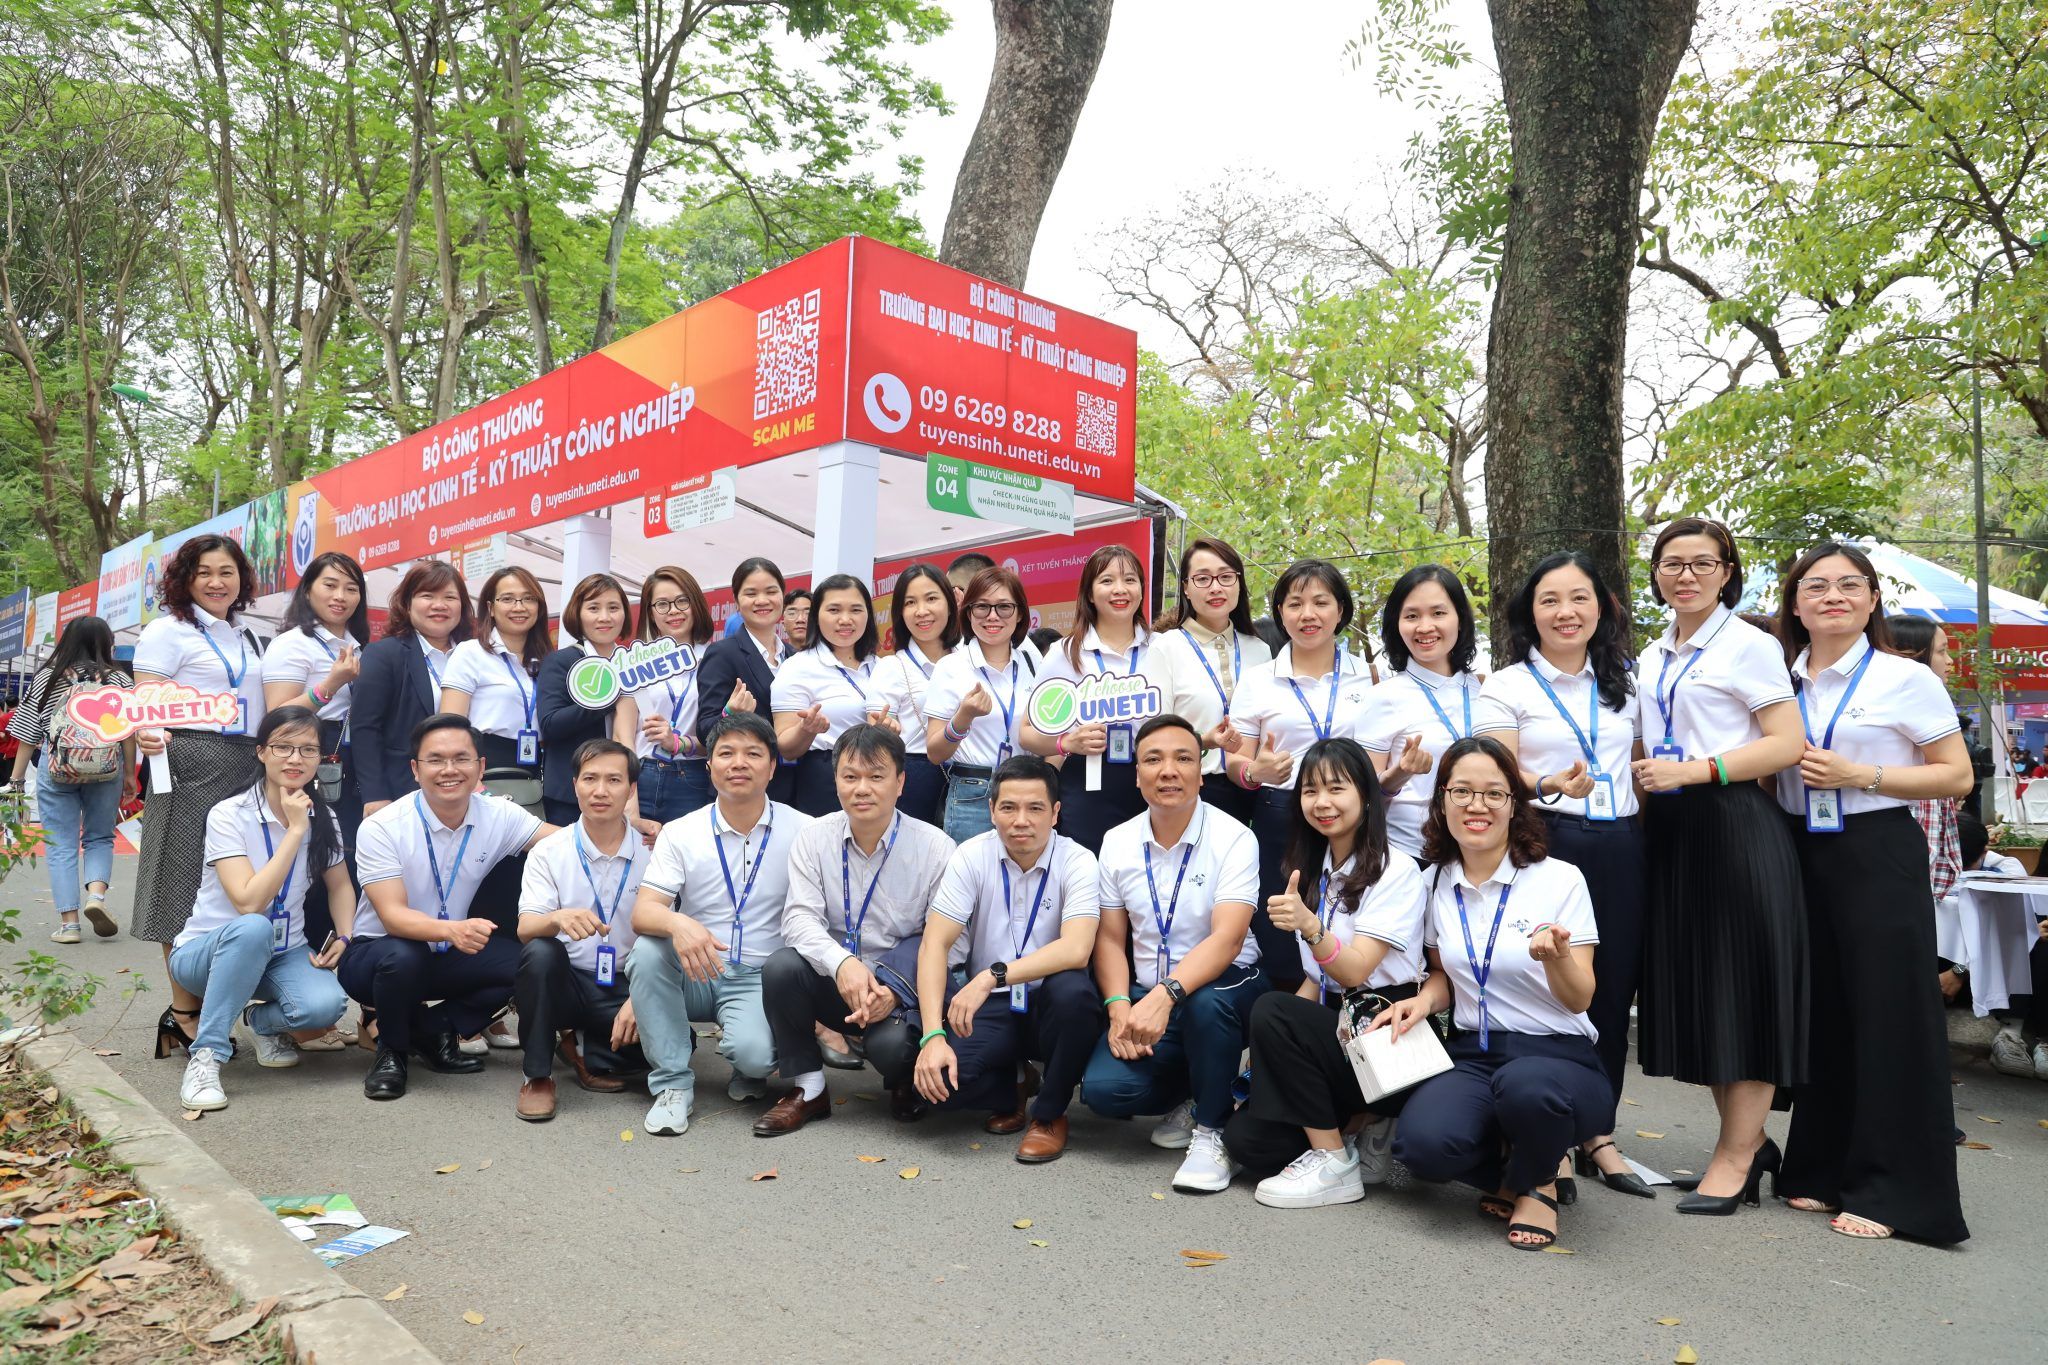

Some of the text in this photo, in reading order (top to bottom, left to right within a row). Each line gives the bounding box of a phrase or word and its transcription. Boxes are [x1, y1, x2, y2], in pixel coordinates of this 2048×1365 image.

[970, 282, 1056, 333] BỘ CÔNG THƯƠNG
[880, 289, 925, 326] TRƯỜNG
[928, 305, 947, 336] ĐẠI
[949, 311, 971, 343] HỌC
[973, 319, 999, 349] KINH
[1001, 325, 1014, 353] TẾ
[1036, 340, 1065, 373] THUẬT
[1067, 348, 1093, 378] CÔNG
[1094, 359, 1127, 392] NGHIỆP
[919, 385, 1062, 443] 09 6269 8288
[422, 398, 544, 475] BỘ CÔNG THƯƠNG
[752, 413, 815, 447] SCAN ME
[335, 503, 376, 538] TRƯỜNG
[378, 496, 398, 528] ĐẠI
[401, 486, 426, 520] HỌC
[428, 474, 459, 508] KINH
[462, 456, 479, 497] TẾ
[489, 449, 508, 488] KỸ
[511, 432, 561, 480] THUẬT
[565, 416, 615, 461] CÔNG
[620, 382, 695, 443] NGHIỆP
[919, 420, 1101, 479] tuyensinh.uneti.edu.vn
[937, 463, 959, 475] ZONE
[973, 466, 1037, 489] KHU VỰC NHẬN QUÀ
[546, 468, 640, 508] tuyensinh.uneti.edu.vn
[935, 476, 959, 499] 04
[992, 489, 1021, 501] CHECK-IN
[1039, 499, 1057, 508] UNETI
[440, 506, 516, 540] tuyensinh@uneti.edu.vn
[648, 506, 661, 525] 03
[619, 648, 692, 688] UNETI
[629, 641, 671, 665] choose
[160, 687, 192, 703] love
[1095, 677, 1142, 697] choose
[126, 701, 211, 722] UNETI
[1080, 692, 1156, 721] UNETI
